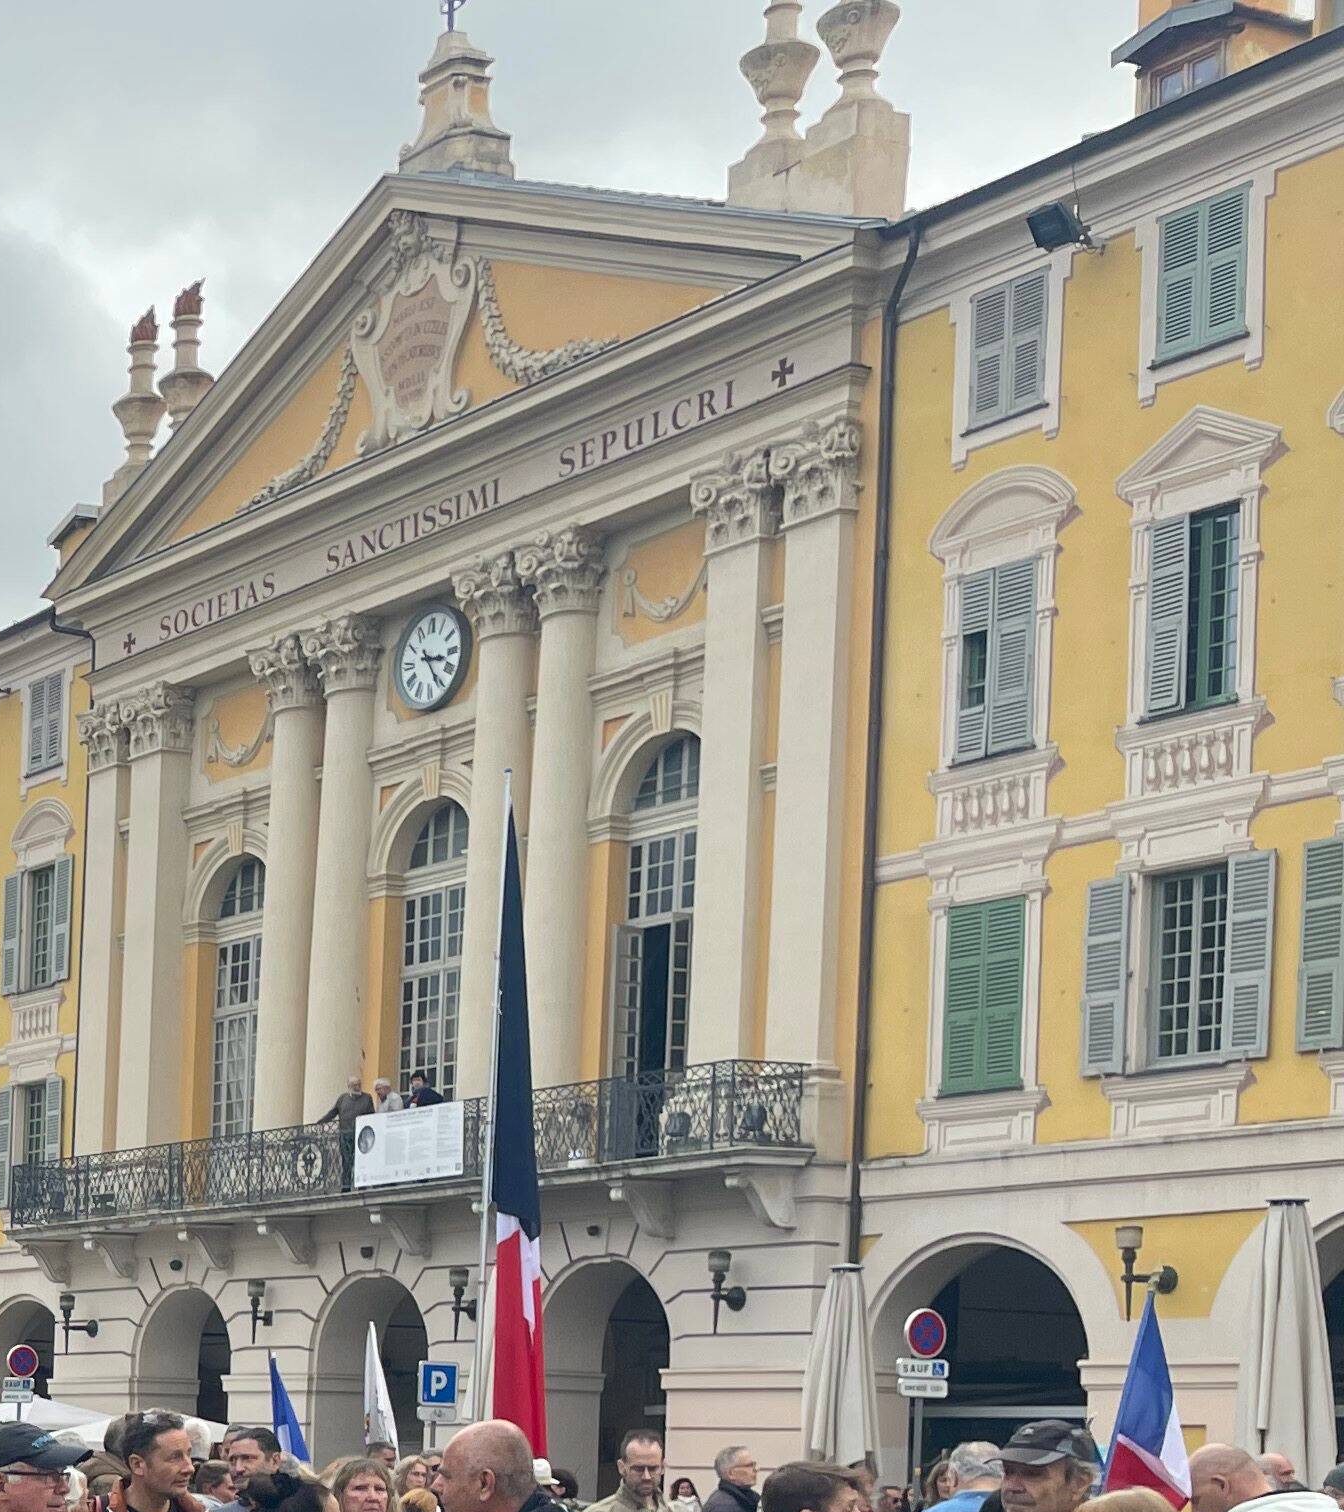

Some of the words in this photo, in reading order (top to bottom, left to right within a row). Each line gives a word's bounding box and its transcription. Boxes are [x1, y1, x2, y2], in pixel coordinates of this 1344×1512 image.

[158, 571, 276, 641] SOCIETAS
[325, 479, 502, 573] SANCTISSIMI
[558, 379, 736, 478] SEPULCRI
[903, 1364, 930, 1373] SAUF
[430, 1370, 448, 1397] P
